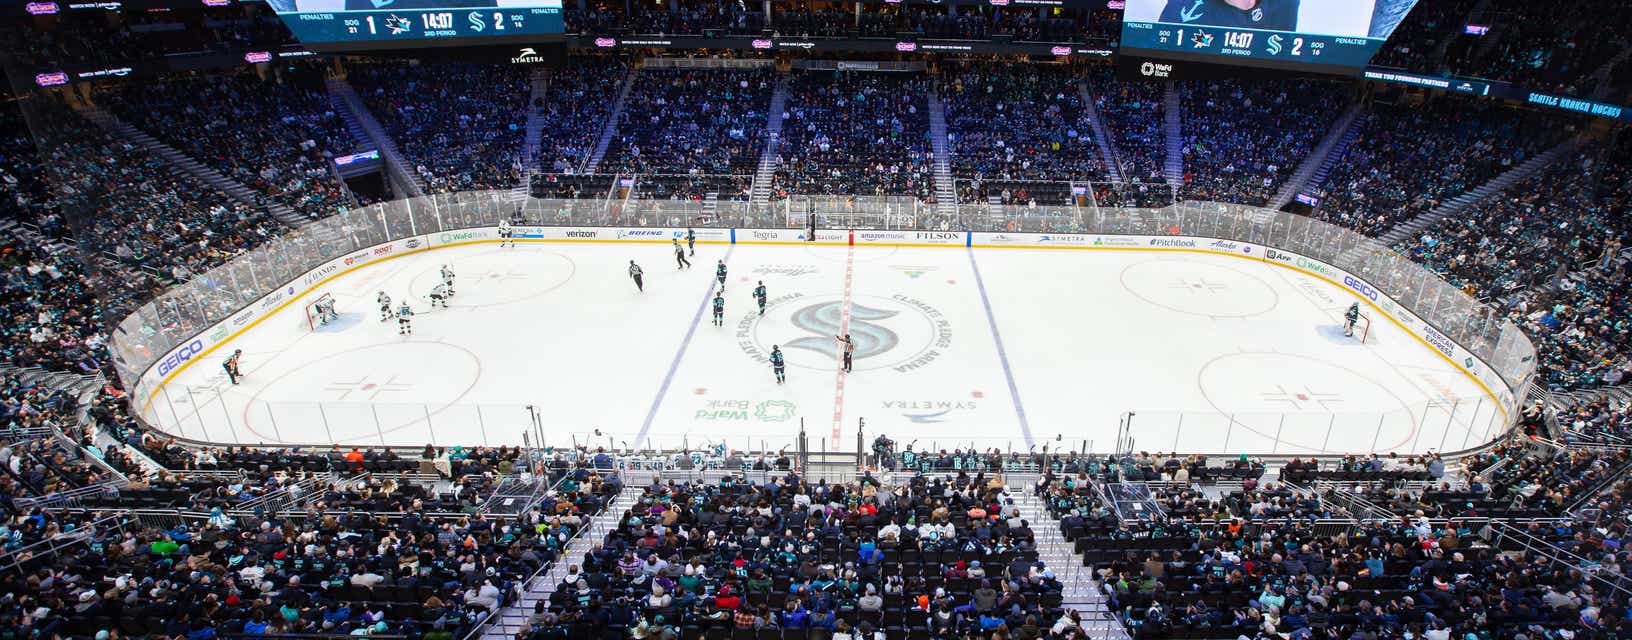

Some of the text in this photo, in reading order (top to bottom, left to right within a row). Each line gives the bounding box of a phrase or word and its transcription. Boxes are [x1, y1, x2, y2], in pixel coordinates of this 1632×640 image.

[366, 15, 376, 34] 1
[421, 13, 453, 29] 14:07
[493, 12, 505, 30] 2
[1176, 29, 1183, 46] 1
[1223, 32, 1253, 48] 14:07
[1335, 37, 1367, 45] PENALTIES
[1291, 37, 1304, 56] 2
[511, 56, 544, 64] SYMETRA
[1154, 63, 1172, 72] WaFd
[1154, 70, 1169, 78] Bank
[1529, 93, 1622, 118] SEATTLE KRAKEN HOCKEY
[453, 230, 473, 241] WaFd
[566, 230, 595, 239] verizon
[753, 231, 777, 240] Tegria
[861, 232, 886, 240] amazon
[916, 232, 960, 240] FILSON
[1157, 238, 1196, 248] PitchBook
[1308, 261, 1325, 273] WaFd
[1344, 276, 1378, 302] GEICO
[1423, 326, 1456, 351] AMERICAN
[1425, 335, 1453, 358] EXPRESS
[157, 339, 204, 377] GEICO
[892, 350, 940, 373] ARENA
[881, 401, 978, 409] SYMETRA
